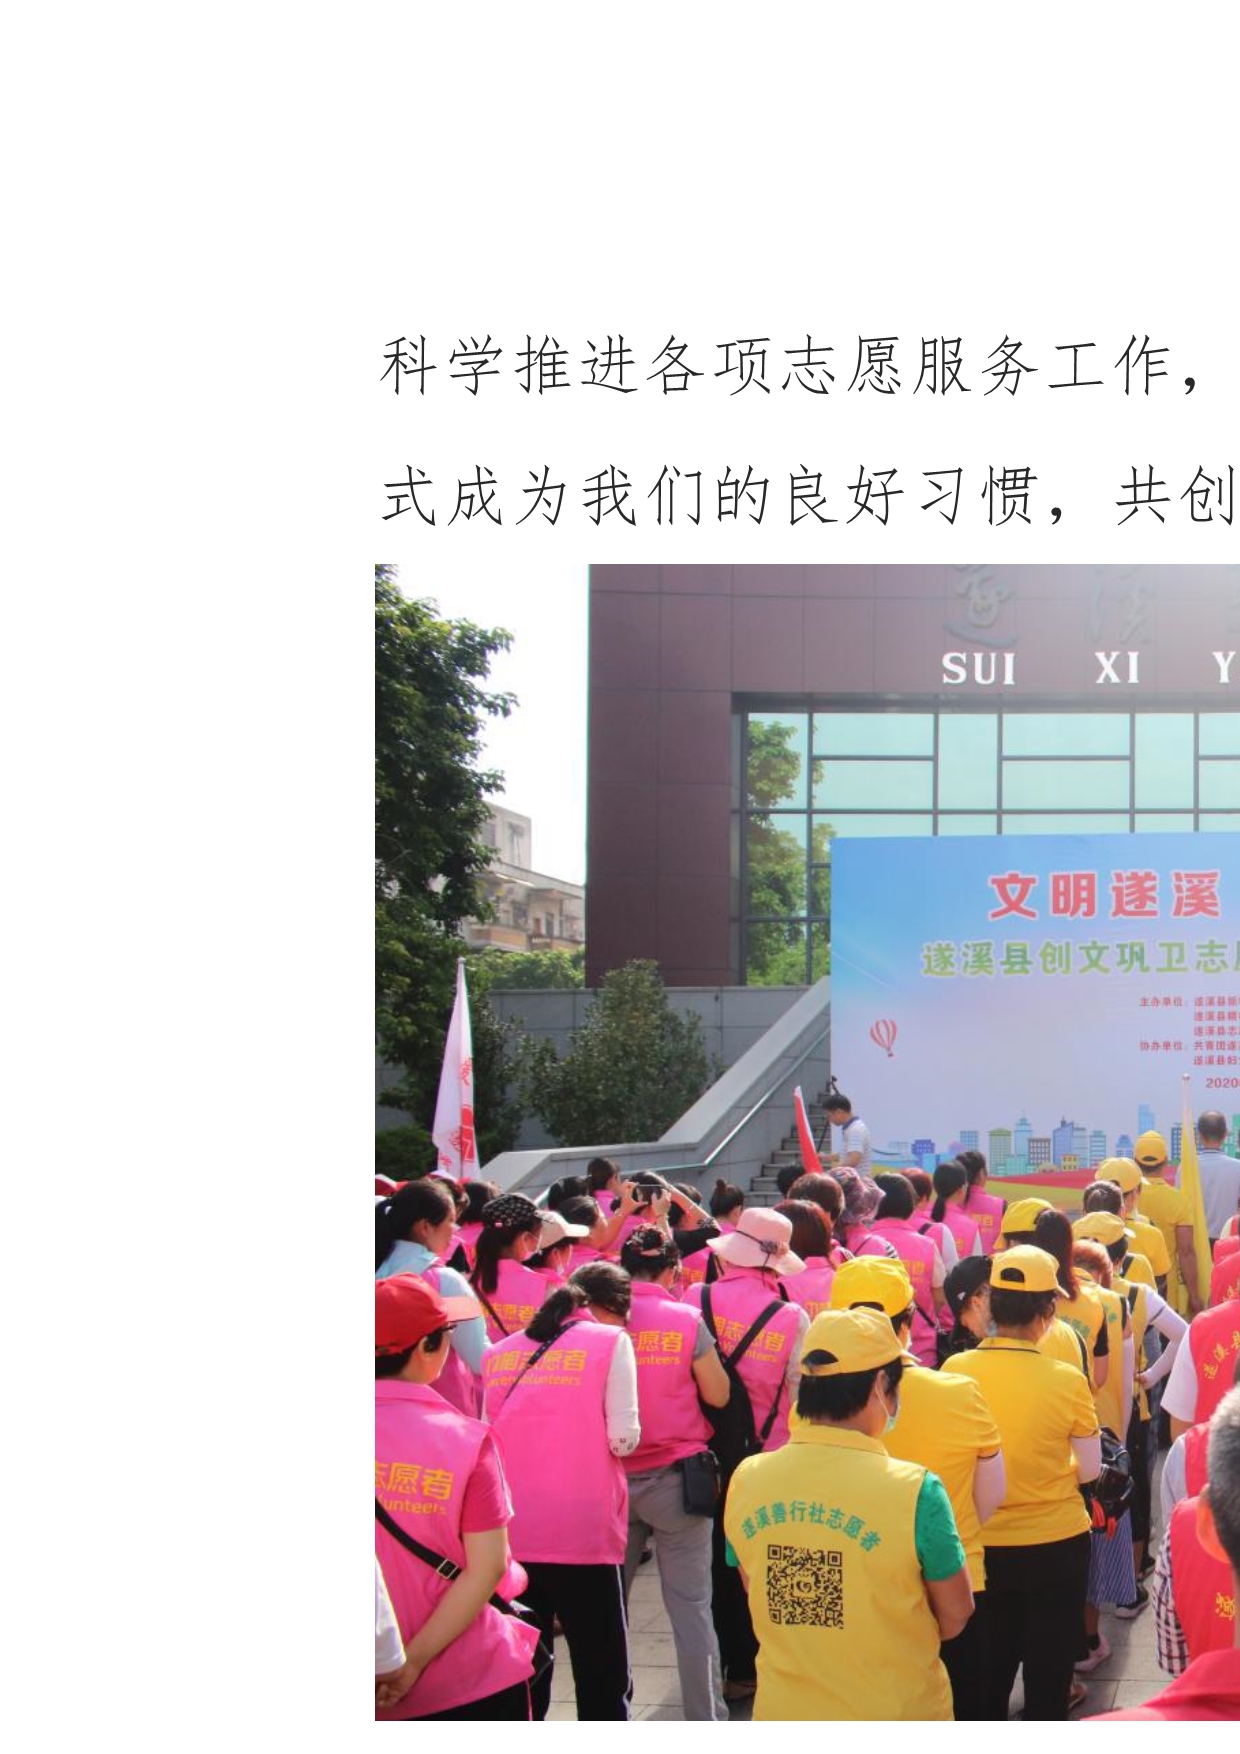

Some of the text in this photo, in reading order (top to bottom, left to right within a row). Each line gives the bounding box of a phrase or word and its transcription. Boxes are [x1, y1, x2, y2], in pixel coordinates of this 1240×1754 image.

[942, 652, 1015, 685] SUI
[1095, 651, 1140, 684] XI
[989, 870, 1221, 919] 文明遂溪
[741, 1500, 882, 1552] 遂溪善行社志愿者
